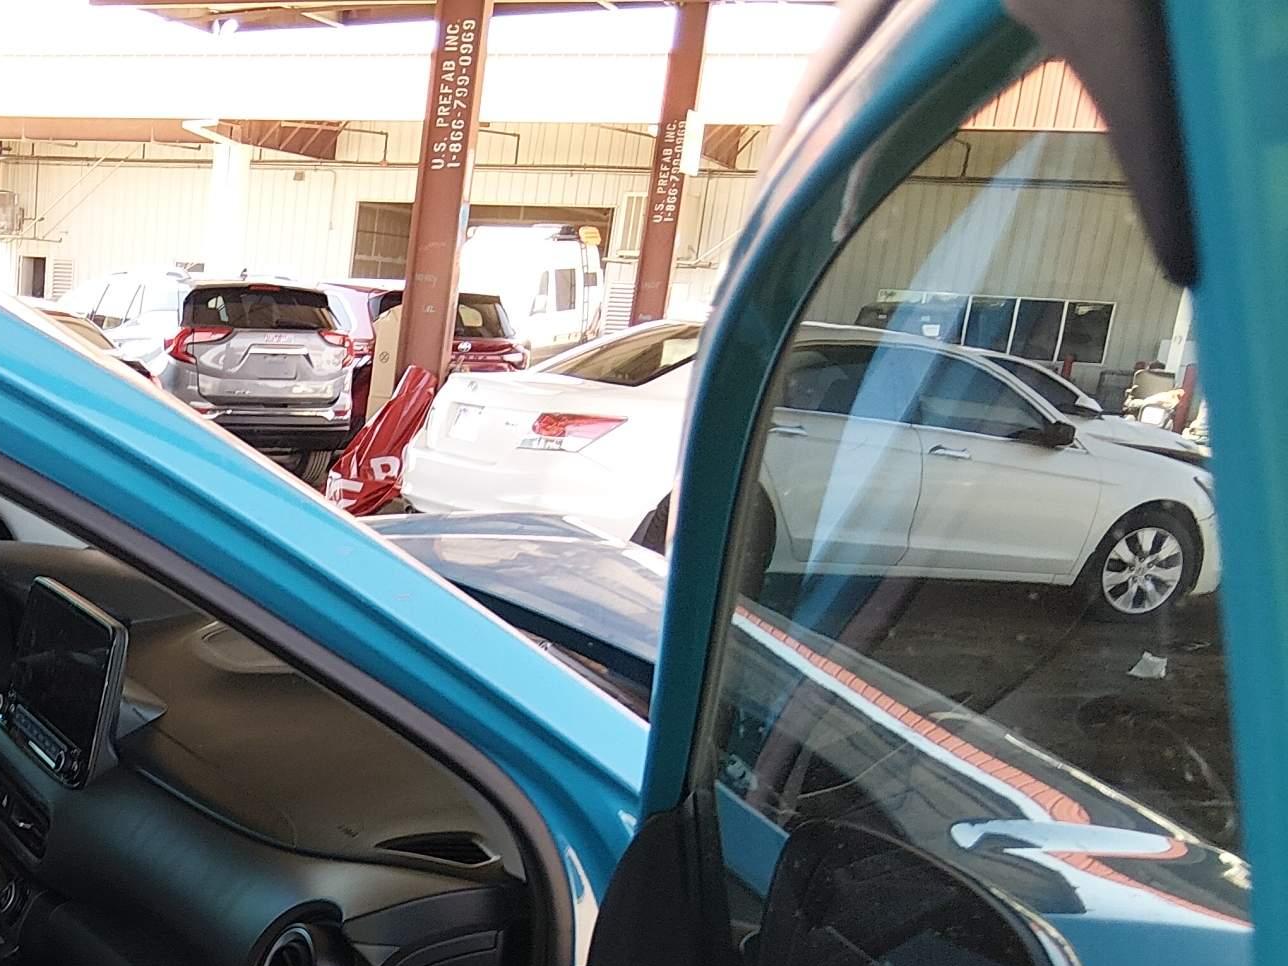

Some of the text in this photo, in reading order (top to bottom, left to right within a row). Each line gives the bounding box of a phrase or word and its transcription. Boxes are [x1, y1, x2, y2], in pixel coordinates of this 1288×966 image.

[431, 19, 461, 170] U.S. PREFAB INC.
[447, 19, 476, 169] 1-866-799-0969
[653, 119, 677, 223] U.S. PREFAB INC.
